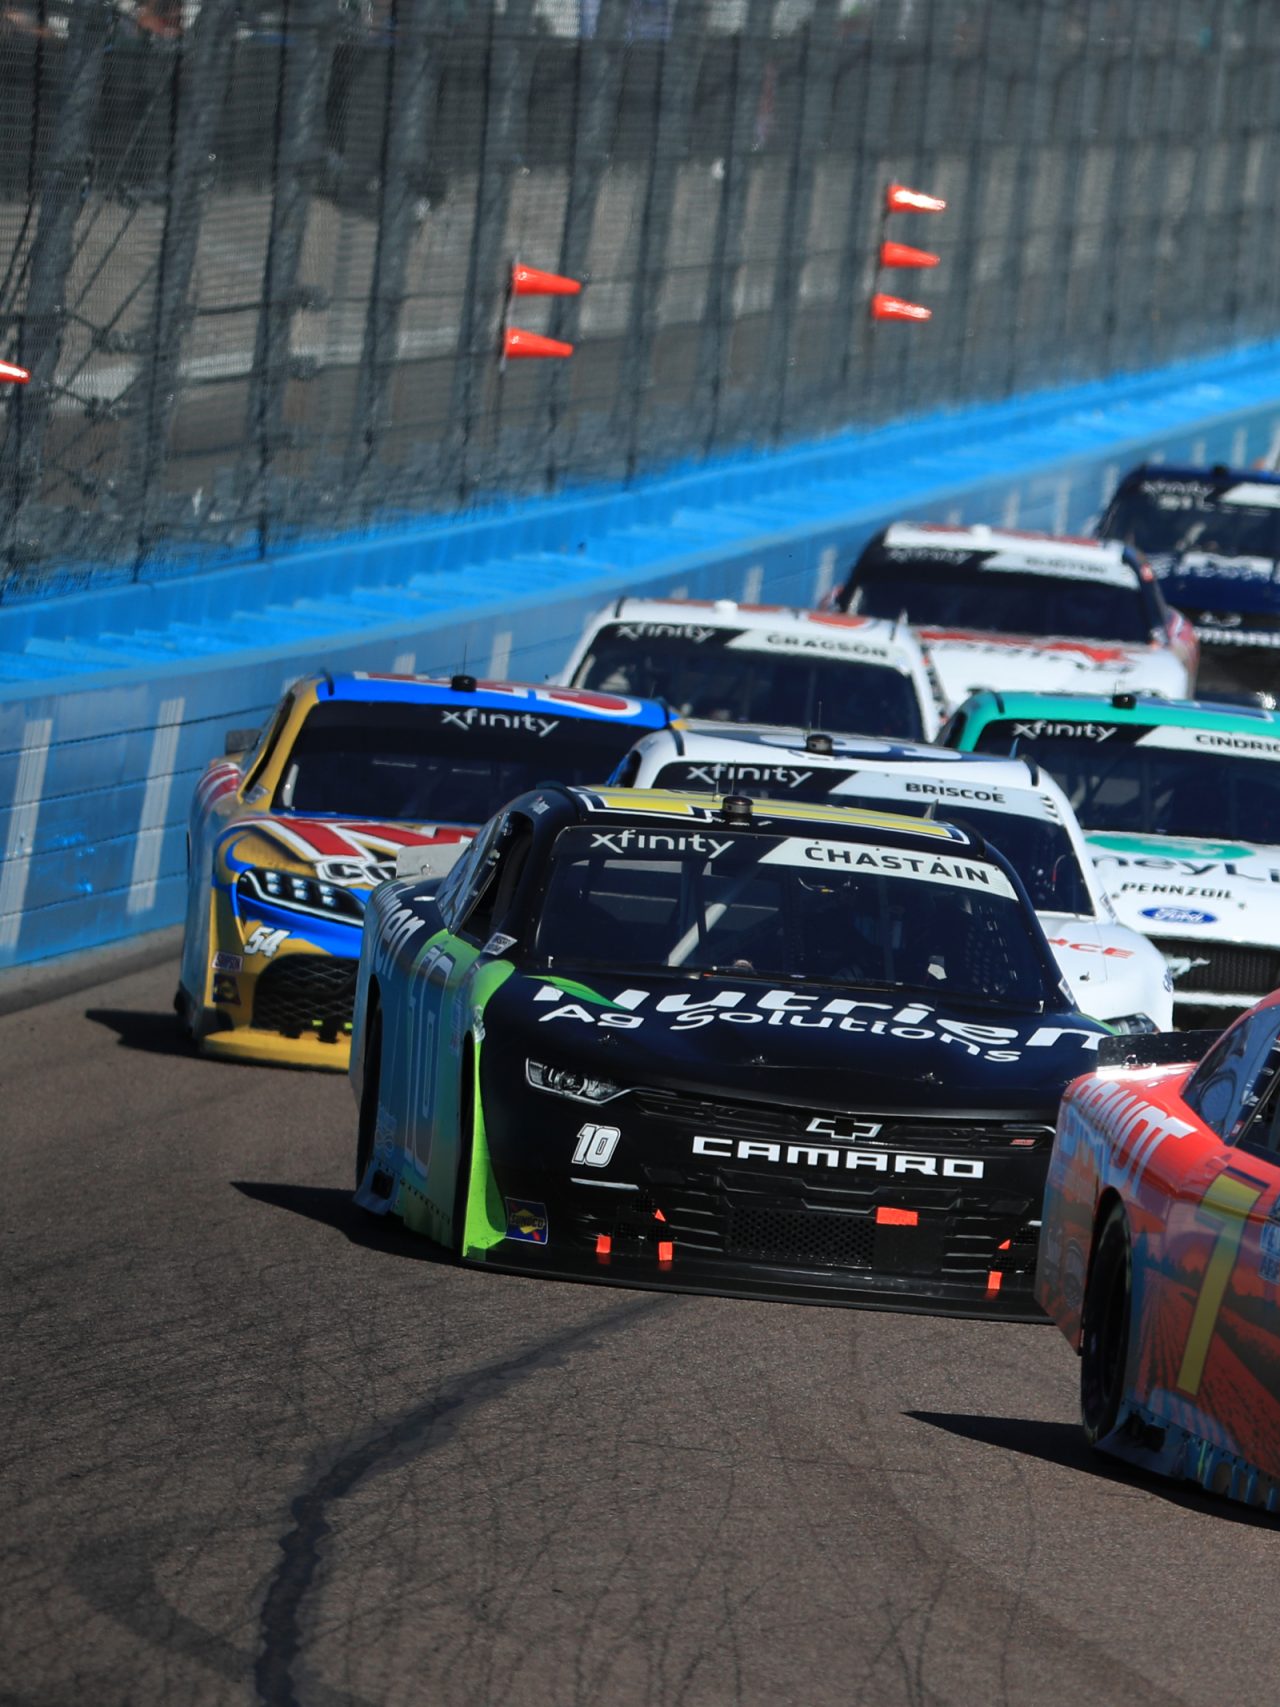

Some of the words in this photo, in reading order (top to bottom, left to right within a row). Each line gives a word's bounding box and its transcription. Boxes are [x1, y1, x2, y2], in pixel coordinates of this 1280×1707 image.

[617, 623, 716, 643] xfinity
[441, 708, 559, 737] xfinity
[1012, 720, 1117, 742] xfinity
[686, 763, 813, 788] xfinity
[905, 782, 1006, 803] BRISCOE
[590, 829, 735, 859] xfinity
[804, 846, 990, 885] CHASTAIN
[1121, 882, 1235, 899] PENNZOIL
[1150, 909, 1206, 923] Ford
[244, 927, 290, 957] 54
[538, 1004, 645, 1029] Ag
[669, 1007, 1021, 1062] Solutions
[571, 1122, 621, 1167] 10
[692, 1136, 985, 1179] CAMARO
[509, 1214, 545, 1229] SUNOCO
[1176, 1166, 1271, 1396] 7
